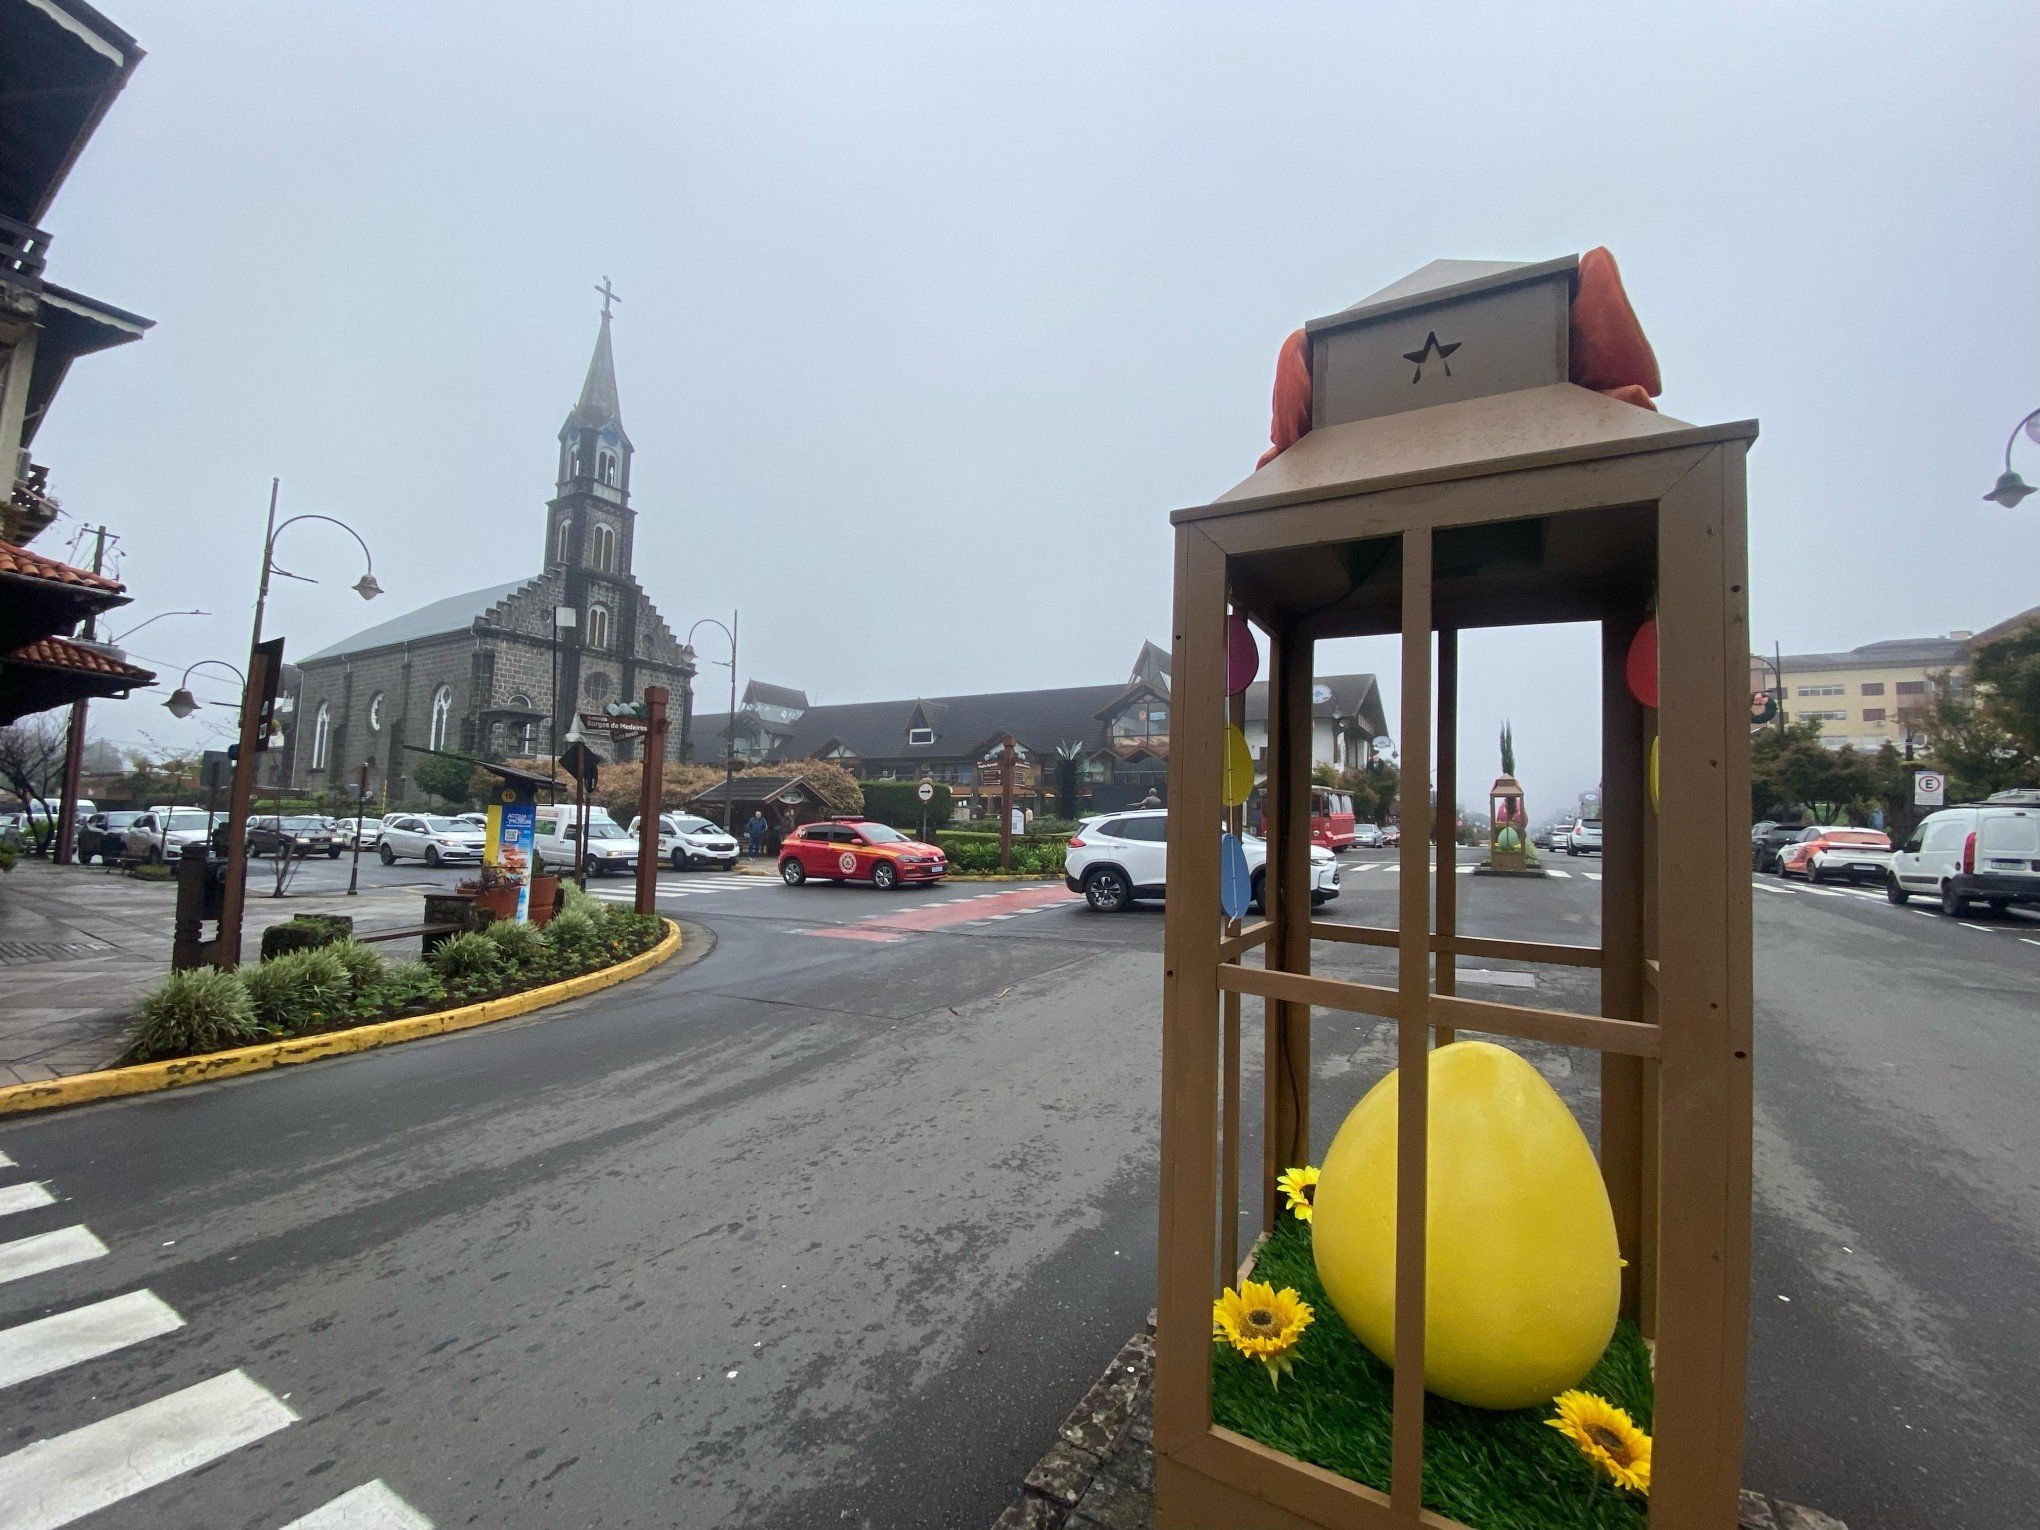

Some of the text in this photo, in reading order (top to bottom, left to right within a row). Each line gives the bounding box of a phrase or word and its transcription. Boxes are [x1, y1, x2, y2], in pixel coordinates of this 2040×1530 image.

[587, 720, 609, 729] Borges
[620, 723, 648, 732] Medeiros
[1925, 779, 1934, 789] E
